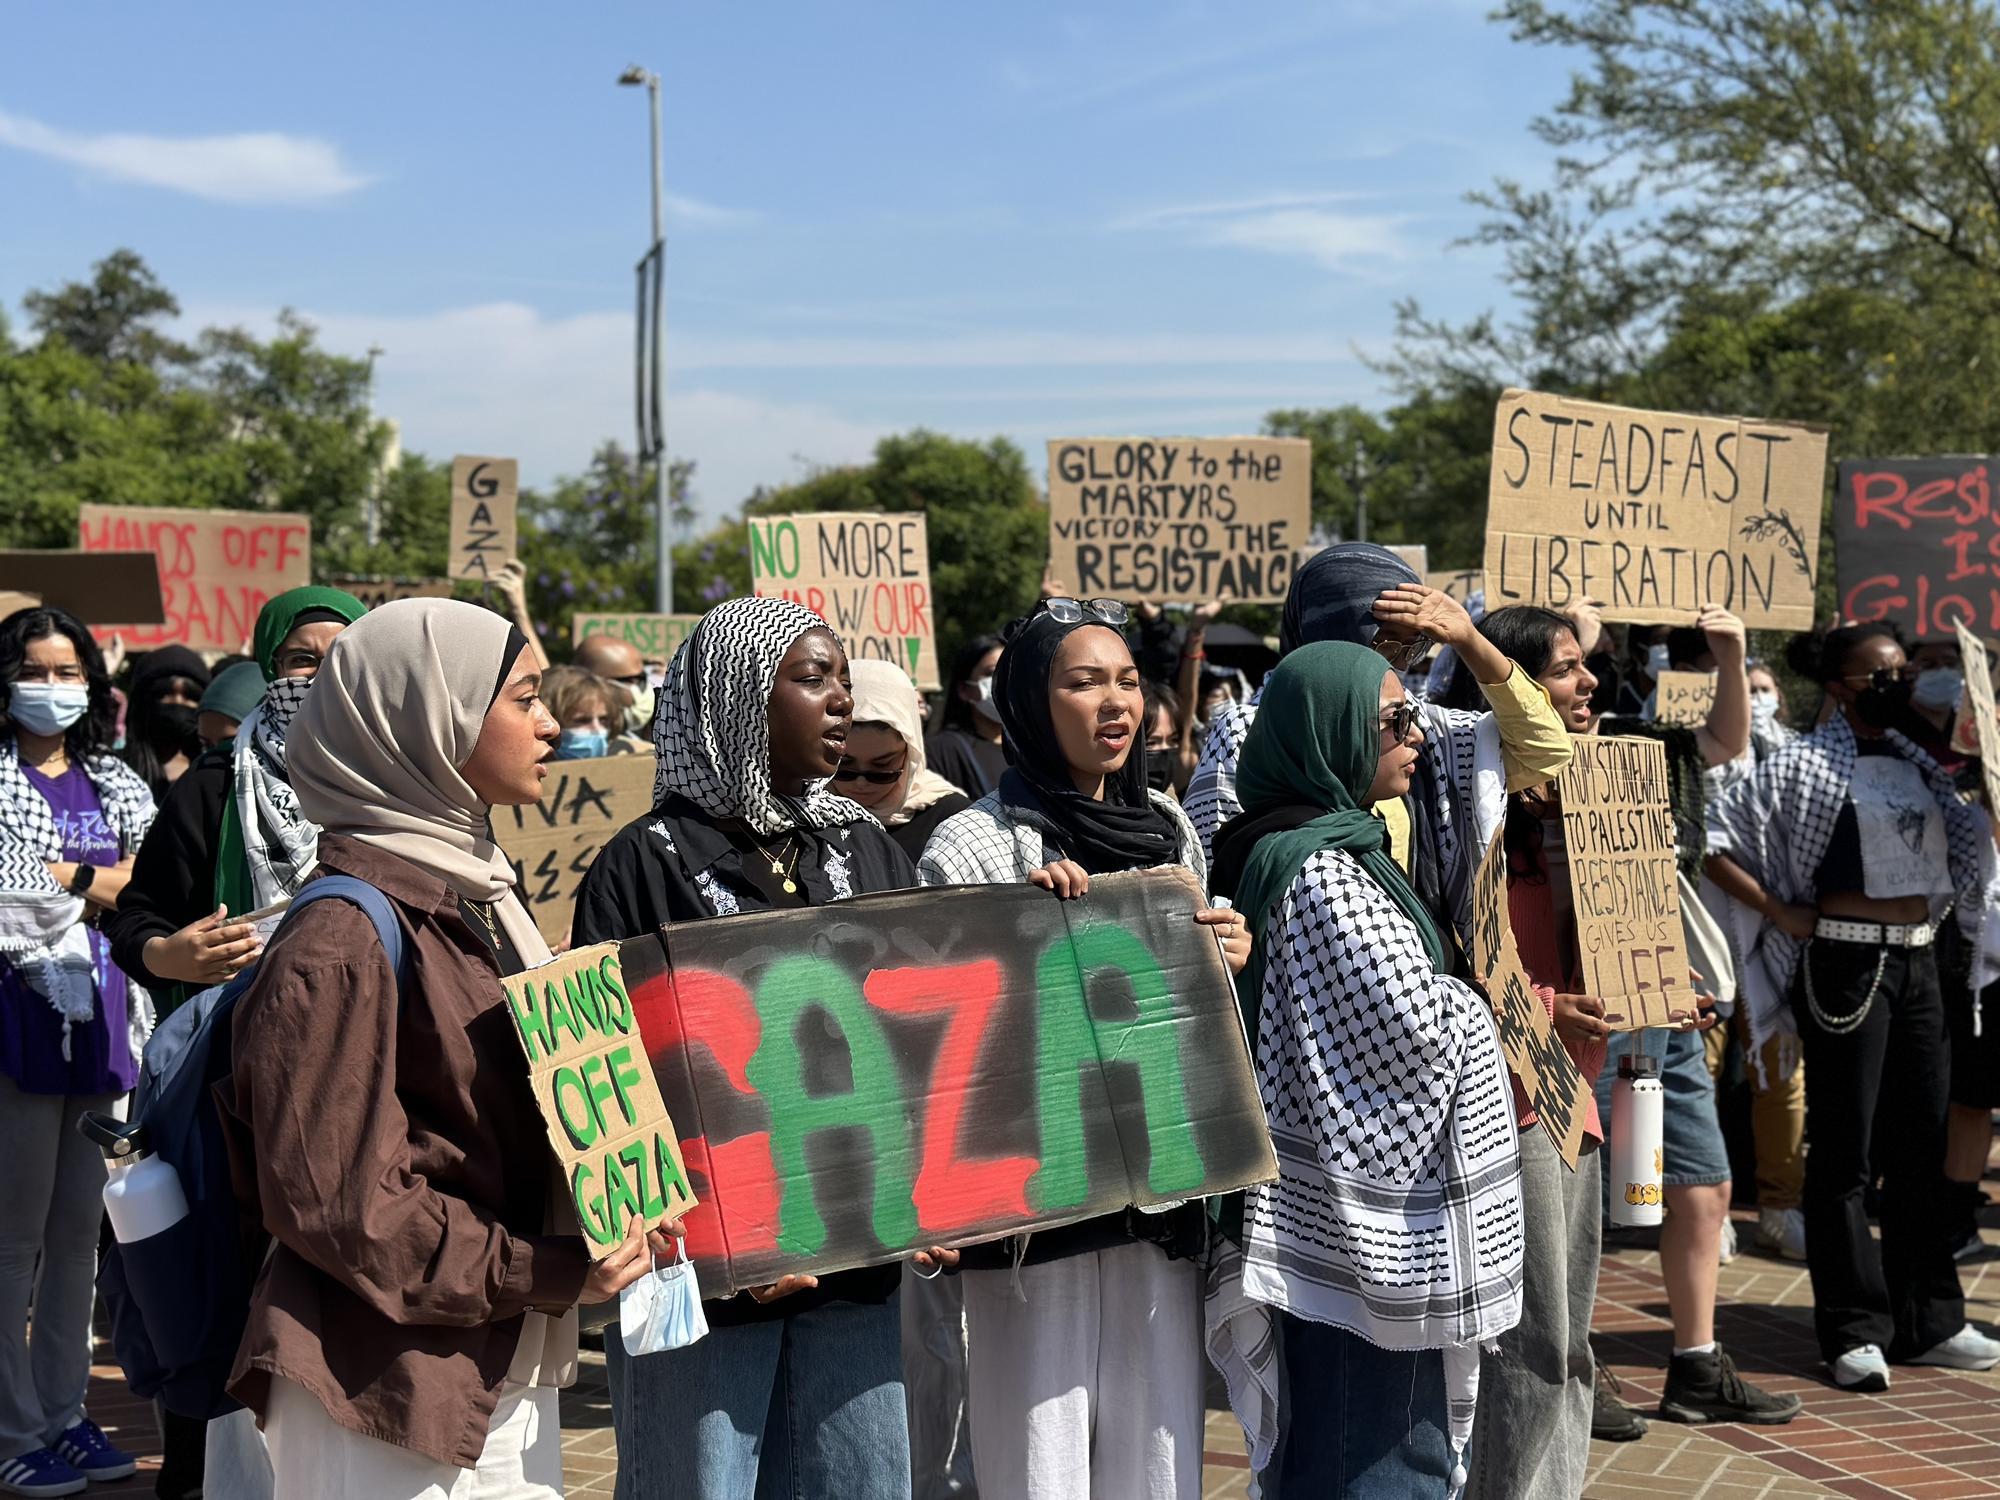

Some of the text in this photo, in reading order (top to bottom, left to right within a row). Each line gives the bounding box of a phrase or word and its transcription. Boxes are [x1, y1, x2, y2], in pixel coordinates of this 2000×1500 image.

[1057, 442, 1281, 483] GLORY to the
[1503, 407, 1792, 504] STEADFAST
[463, 462, 504, 578] GAZA
[1080, 483, 1237, 523] MARTYRS
[1584, 498, 1670, 531] UNTIL
[1852, 465, 2000, 529] Resi
[223, 526, 307, 572] OFF
[751, 520, 919, 579] NO MORE
[1055, 517, 1289, 553] VICTORY TO THE
[1499, 534, 1775, 613] LIBERATION
[873, 582, 929, 637] OUR
[1596, 740, 1669, 807] STONEWALL
[1563, 807, 1674, 855] TO PALESTINE
[1574, 857, 1678, 923] RESISTANCE
[1585, 919, 1668, 954] GIVES US
[505, 954, 633, 1064] HANDS
[1593, 945, 1691, 1027] LIFE
[552, 1045, 642, 1151] OFF
[626, 923, 1206, 1258] GAZA
[571, 1132, 689, 1246] GAZA
[1624, 1182, 1664, 1206] US
